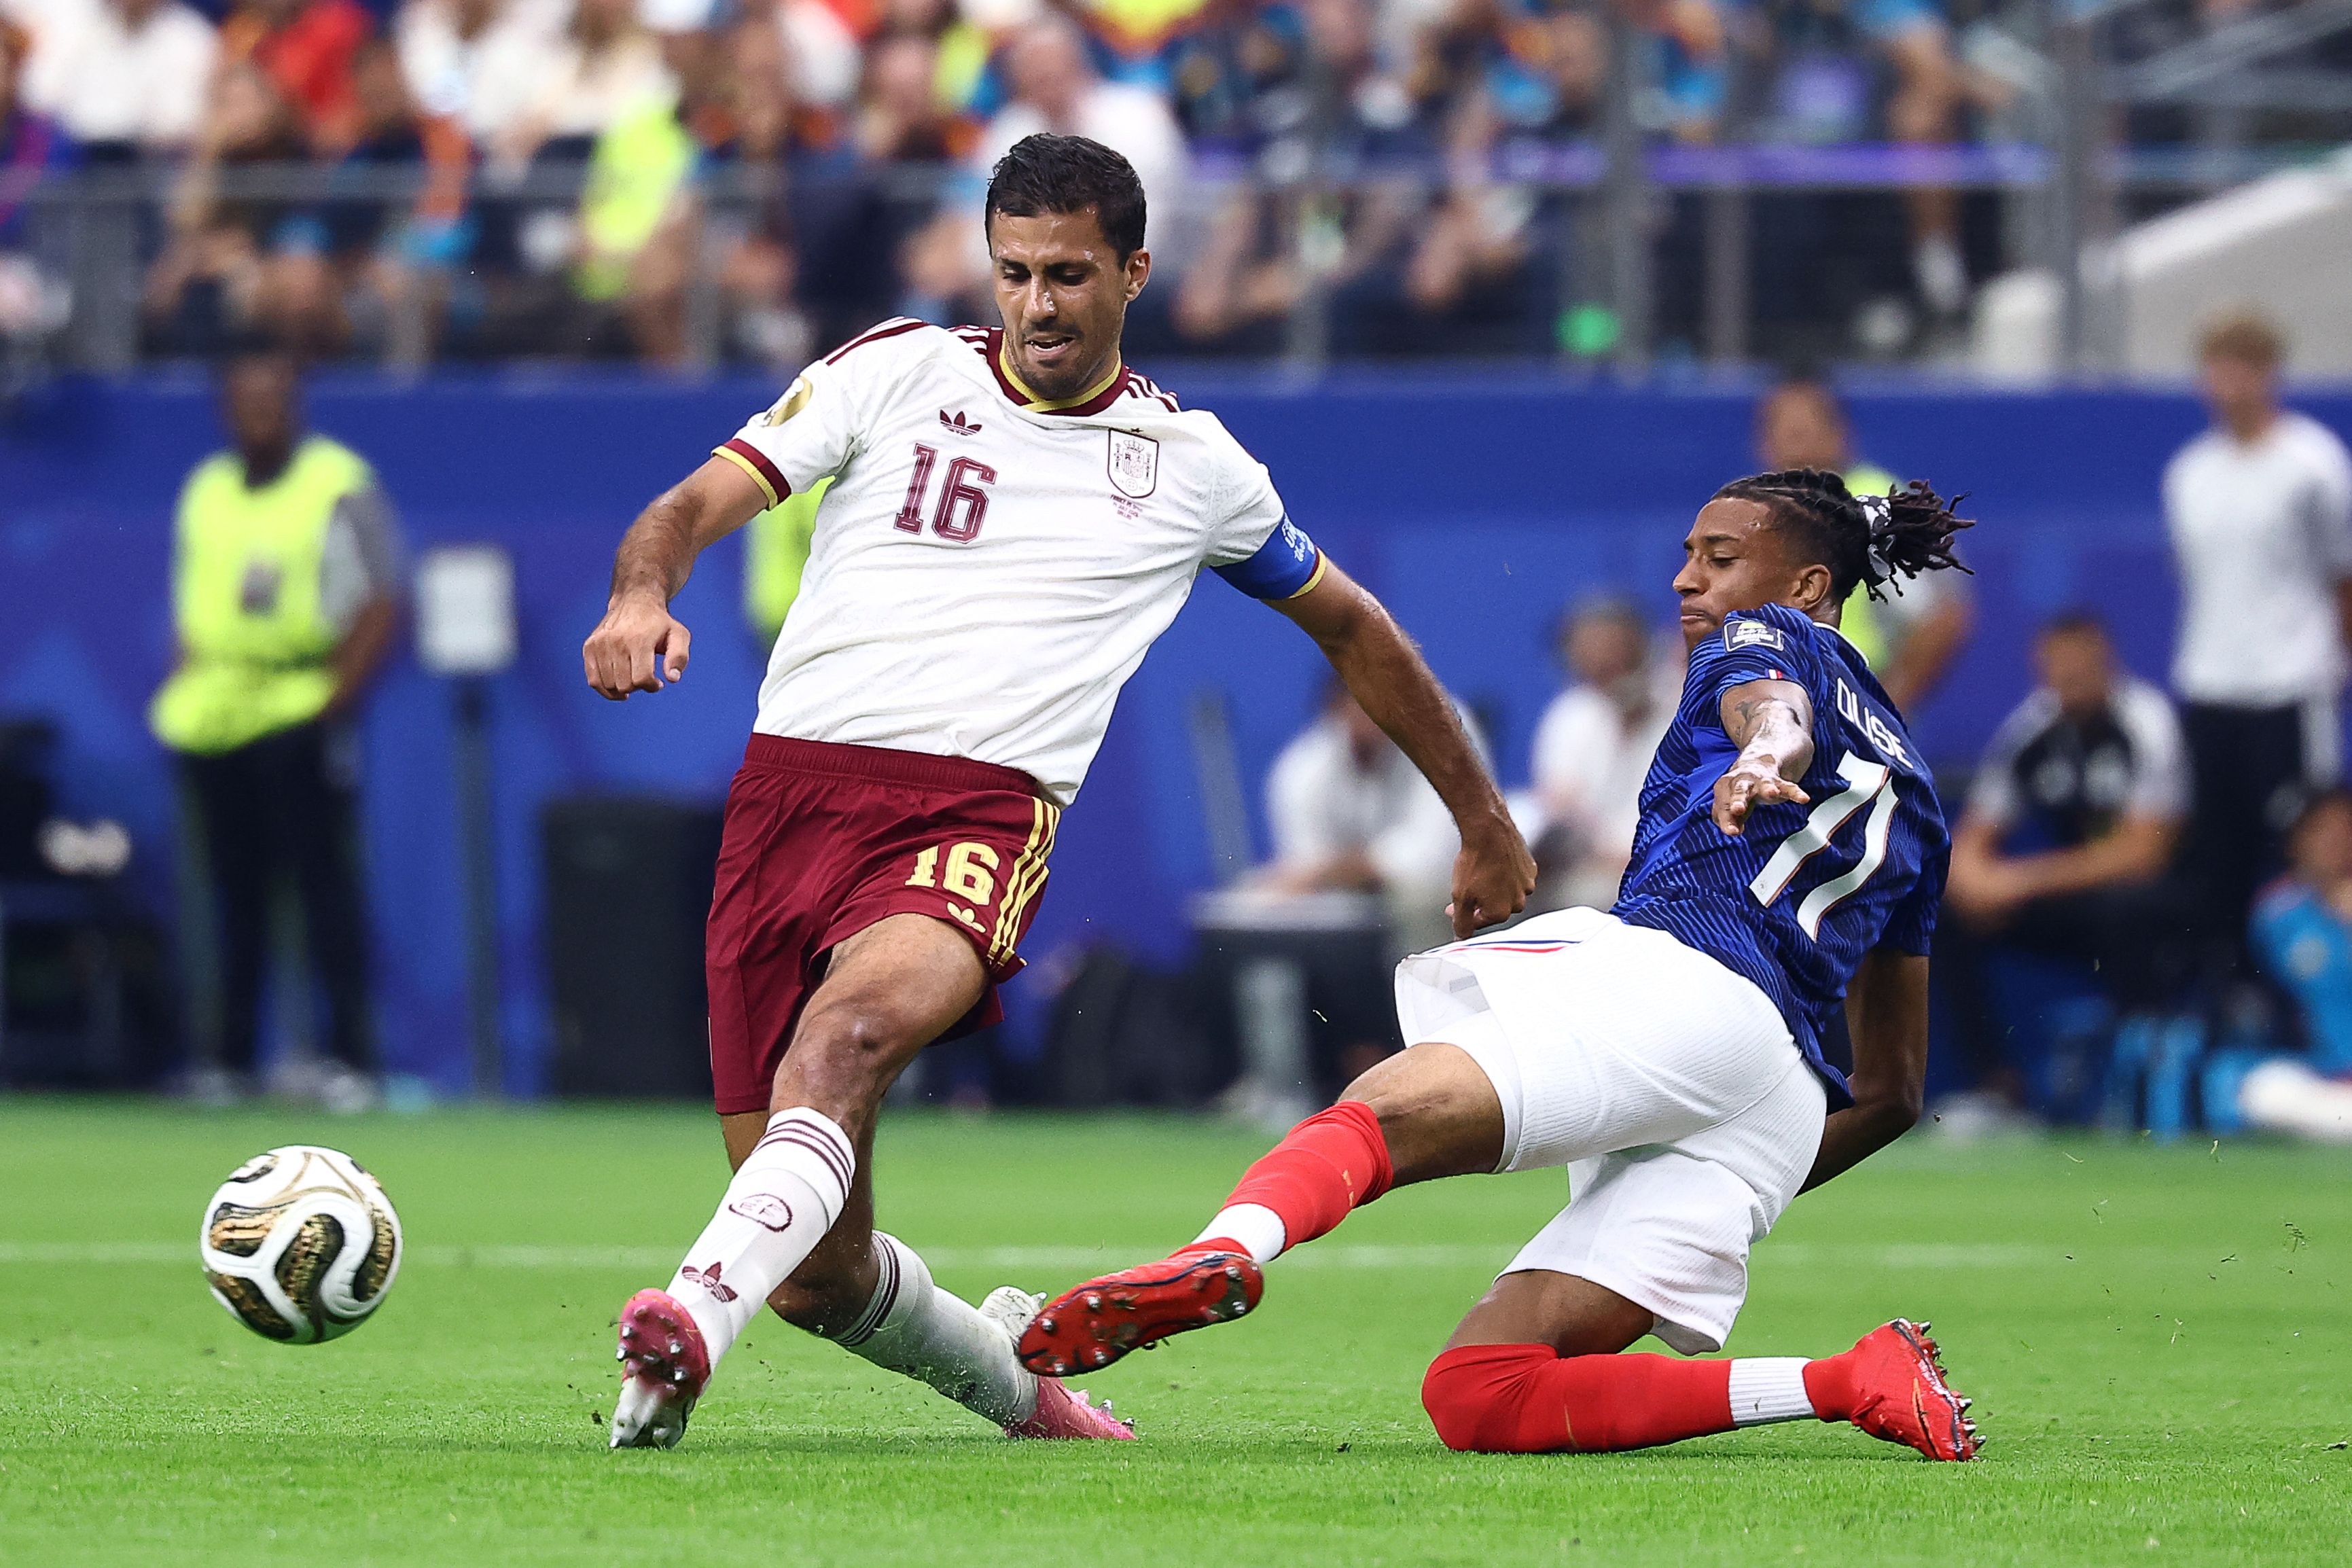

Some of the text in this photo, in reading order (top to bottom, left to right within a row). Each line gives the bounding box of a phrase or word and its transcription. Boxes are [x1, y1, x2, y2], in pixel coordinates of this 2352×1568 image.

[893, 443, 998, 544] 16
[1837, 677, 1914, 769] OLISE
[904, 841, 1000, 906] 16
